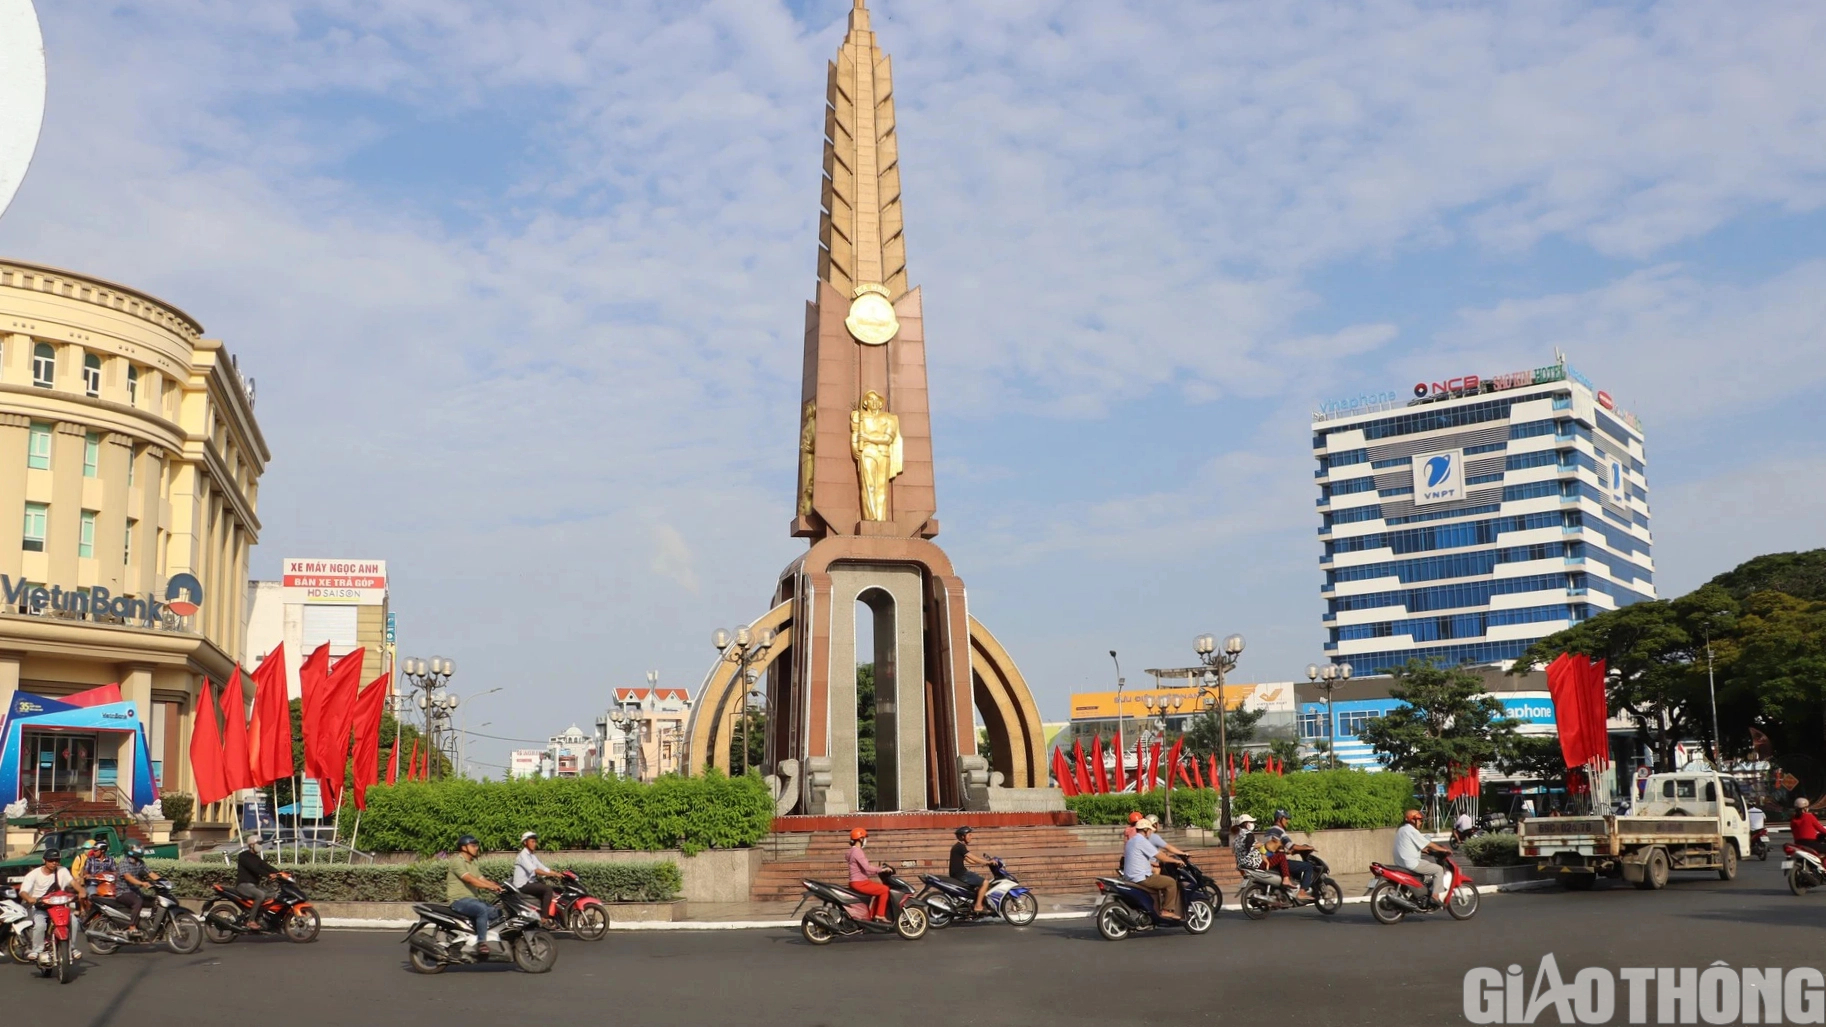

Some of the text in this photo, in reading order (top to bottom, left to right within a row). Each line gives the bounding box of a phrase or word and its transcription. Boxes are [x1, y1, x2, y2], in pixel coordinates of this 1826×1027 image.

[1534, 364, 1565, 384] HOTEL
[1432, 375, 1480, 394] NCB
[1424, 489, 1455, 499] VNPT
[291, 560, 379, 575] XE MÁY NGỌC ANH
[294, 576, 375, 588] BÁN XE TRẢ GÓP
[0, 573, 164, 623] VietinBank
[307, 589, 361, 598] HD SAISON
